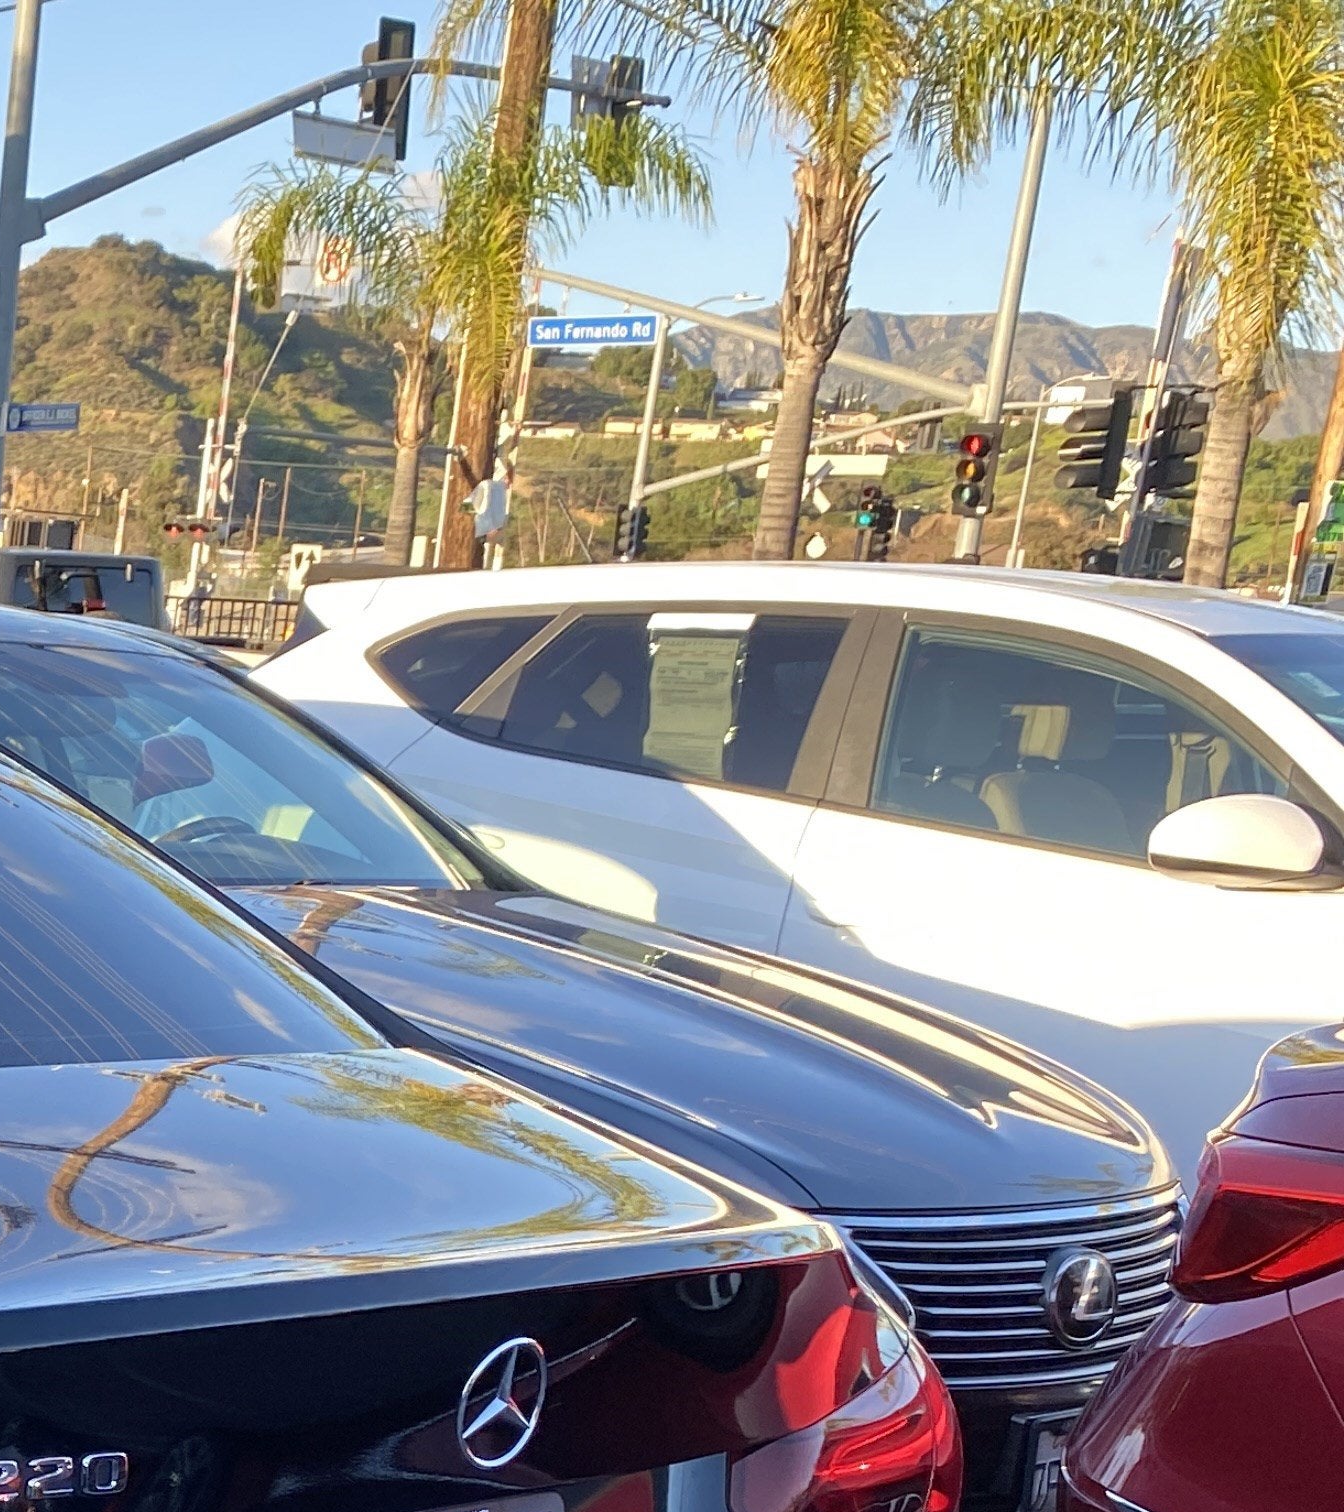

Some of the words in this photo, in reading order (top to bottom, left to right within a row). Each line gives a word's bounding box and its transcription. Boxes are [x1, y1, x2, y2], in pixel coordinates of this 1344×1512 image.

[535, 324, 561, 341] San
[563, 322, 629, 340] Fernando
[632, 320, 651, 338] Rd
